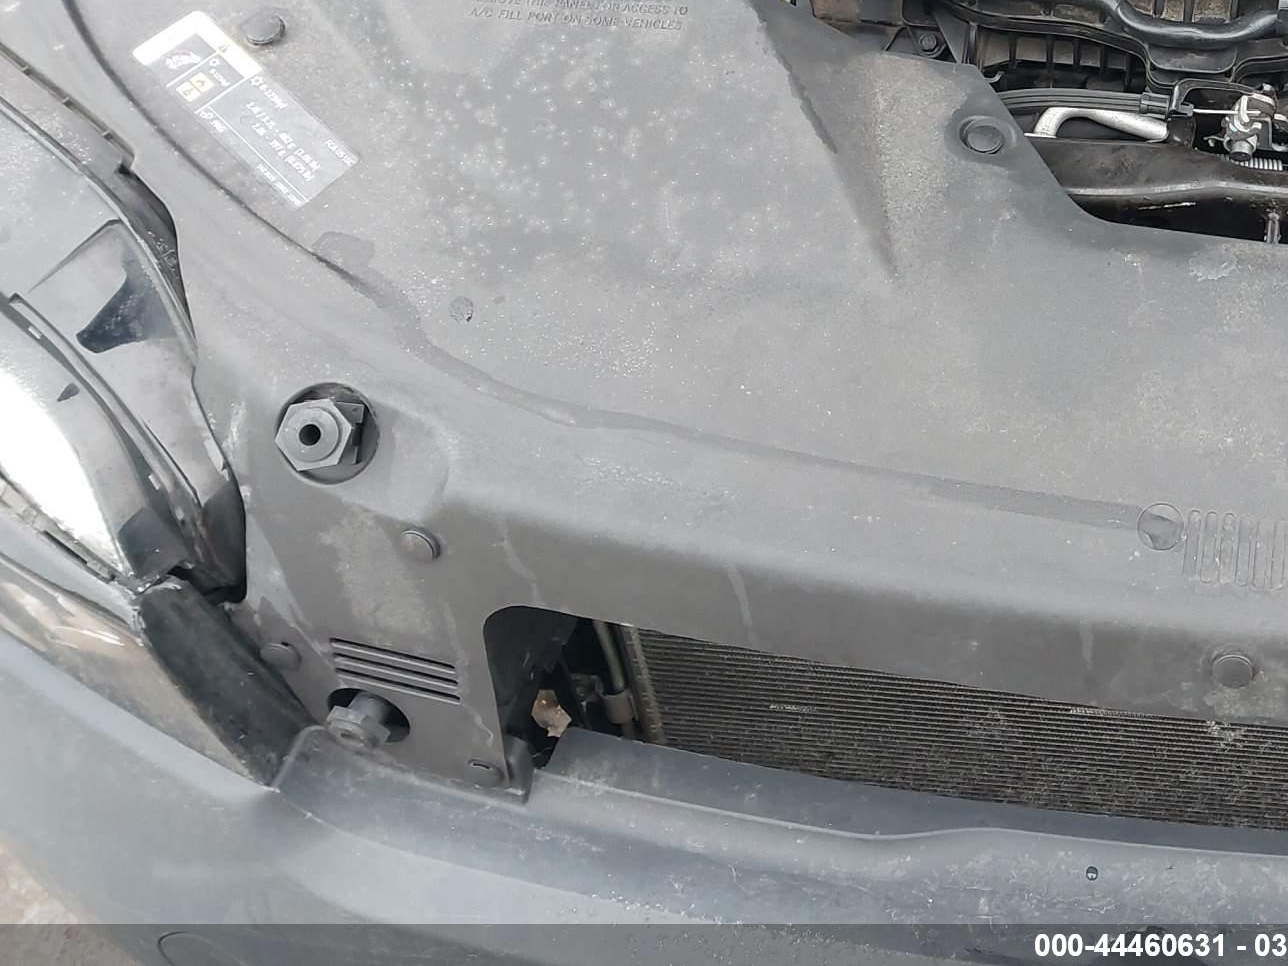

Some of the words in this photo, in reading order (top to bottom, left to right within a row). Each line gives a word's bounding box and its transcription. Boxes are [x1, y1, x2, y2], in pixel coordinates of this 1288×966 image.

[622, 3, 671, 15] ACCESS
[470, 7, 494, 18] A/C
[497, 9, 522, 20] FILL
[528, 11, 559, 23] PORT
[562, 14, 581, 26] ON
[585, 16, 621, 27] SOME
[624, 17, 682, 31] VEHICLES
